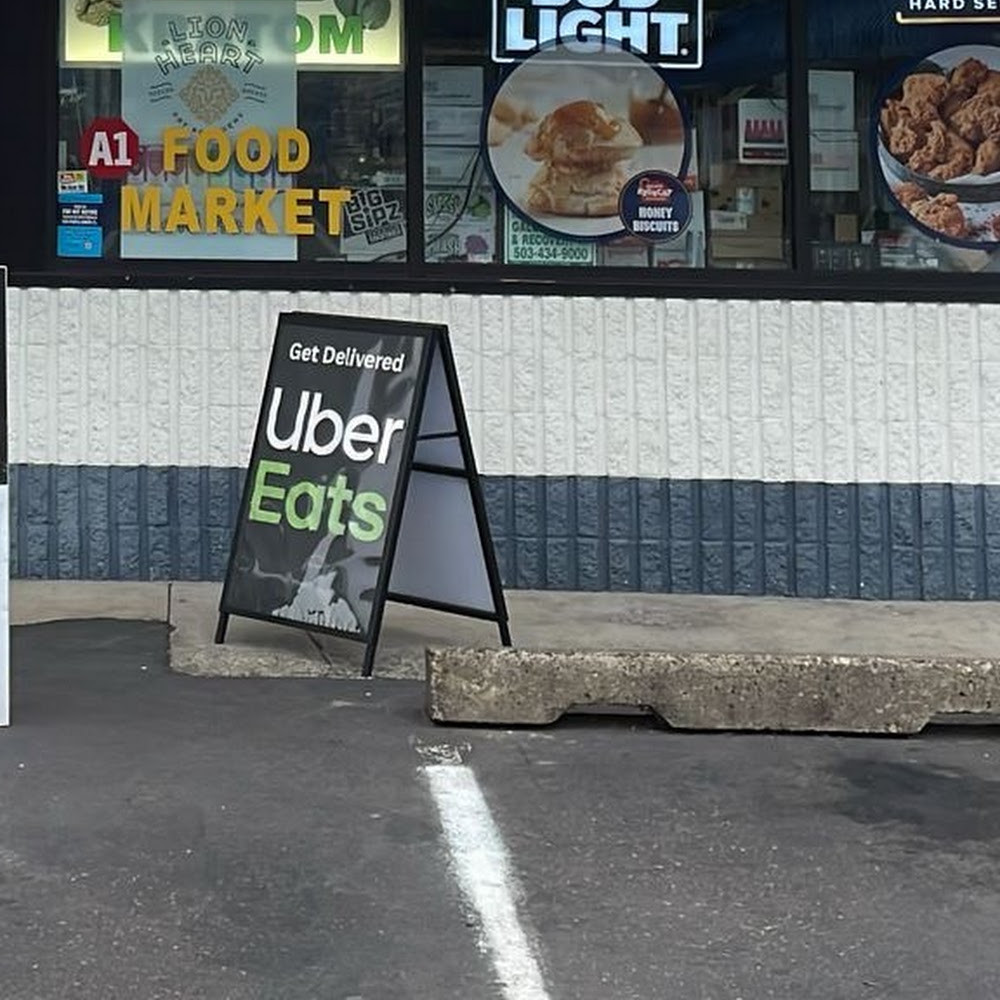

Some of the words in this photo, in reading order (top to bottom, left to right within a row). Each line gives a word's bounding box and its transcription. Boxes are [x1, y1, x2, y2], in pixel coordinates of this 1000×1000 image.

[168, 15, 249, 43] LION
[154, 41, 265, 77] HEART
[88, 131, 134, 167] A1
[161, 127, 311, 174] FOOD
[120, 185, 352, 236] MARKET
[632, 220, 680, 233] BISCUITS
[638, 206, 673, 219] HONEY
[288, 342, 321, 364] Get
[322, 346, 406, 373] Delivered
[265, 386, 406, 465] Uber
[248, 459, 387, 542] Eats
